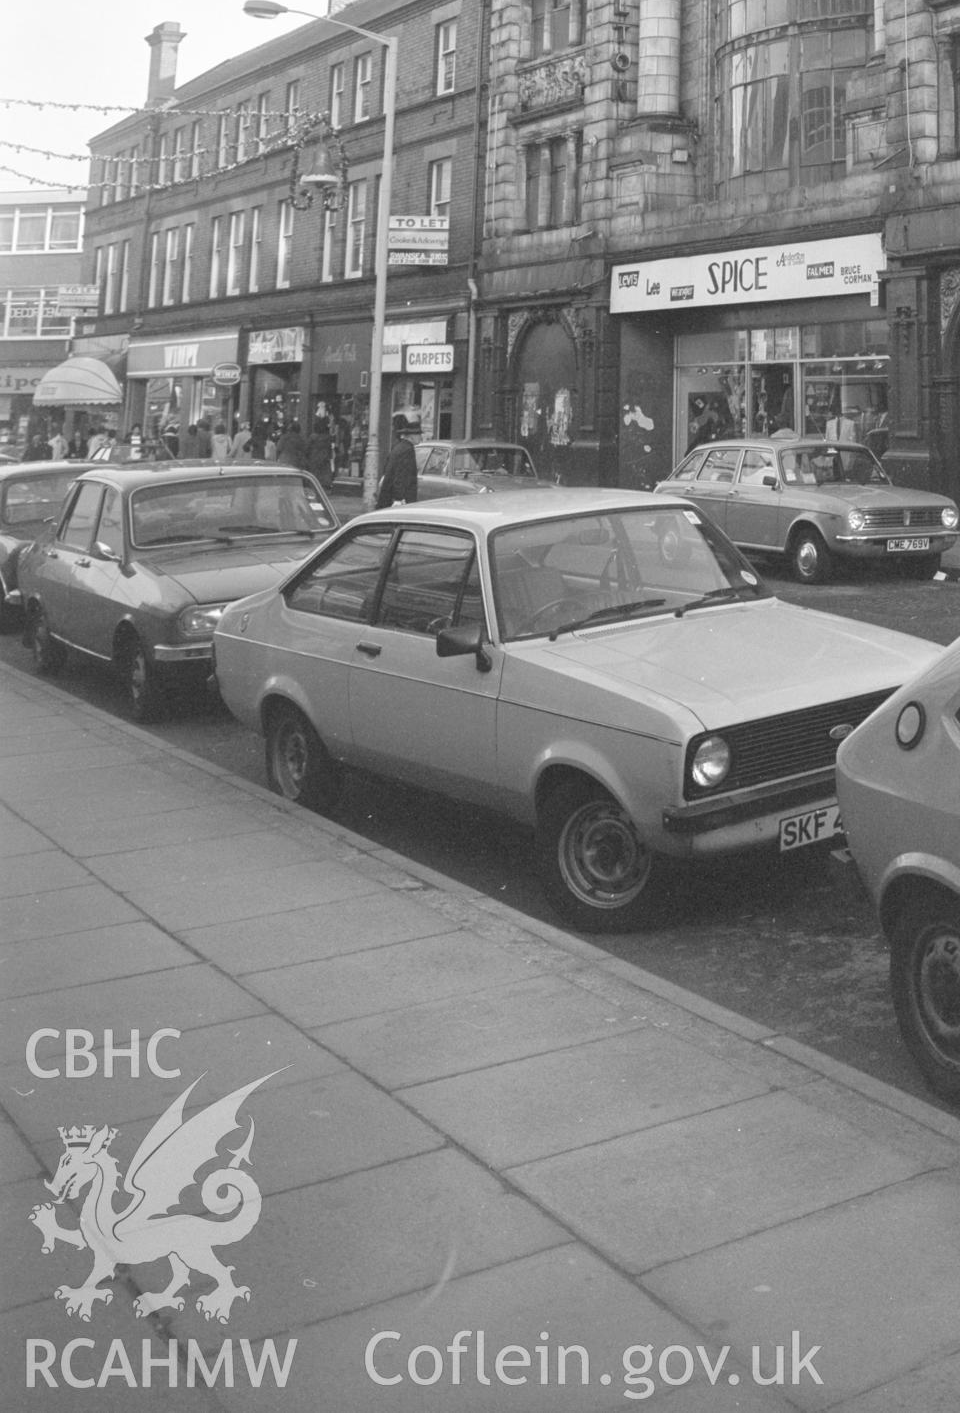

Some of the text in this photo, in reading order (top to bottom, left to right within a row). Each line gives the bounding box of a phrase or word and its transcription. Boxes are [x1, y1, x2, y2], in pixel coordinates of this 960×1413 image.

[395, 218, 447, 228] TO LET
[707, 256, 768, 295] SPICE
[807, 265, 834, 277] FALMER
[840, 265, 861, 276] BRUCE
[843, 274, 872, 285] CORMAN
[646, 278, 661, 296] Lee
[408, 351, 452, 366] CARPETS
[888, 538, 928, 550] CME 769V
[783, 810, 828, 847] SKF
